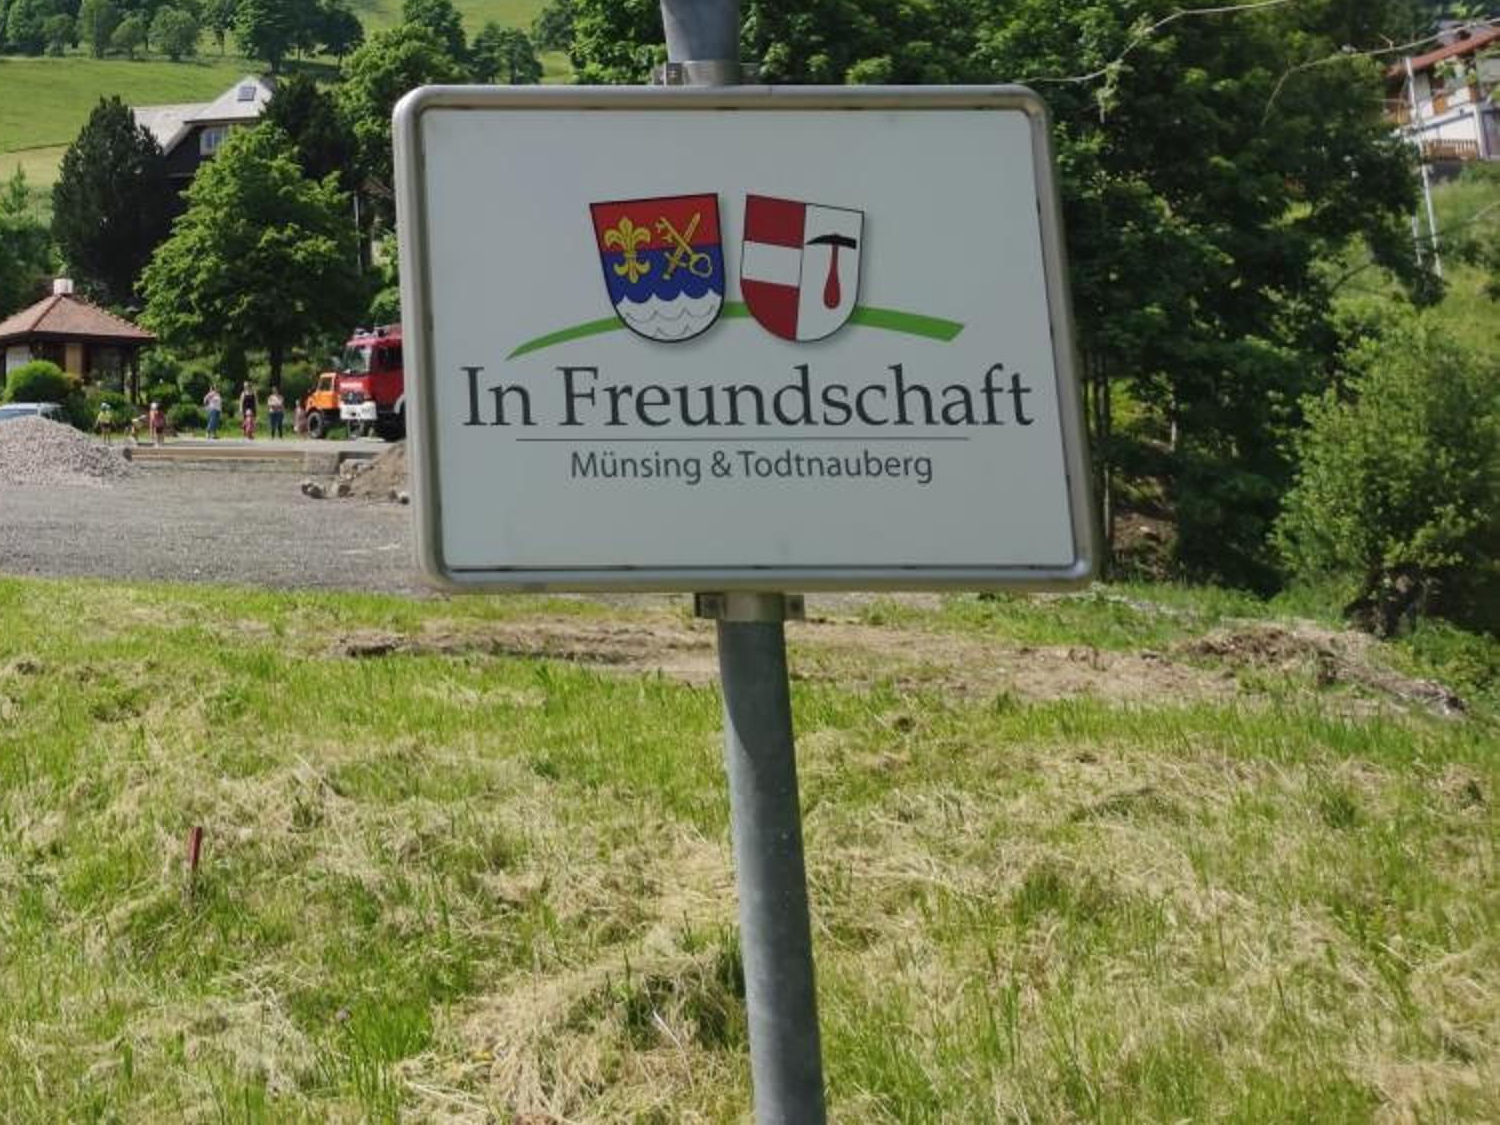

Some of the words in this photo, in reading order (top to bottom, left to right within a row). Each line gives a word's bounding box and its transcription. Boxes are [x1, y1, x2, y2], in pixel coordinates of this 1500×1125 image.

[461, 366, 538, 426] In
[556, 362, 1035, 427] Freundschaft
[571, 450, 702, 486] Münsing
[710, 450, 733, 478] &
[736, 448, 933, 485] Todtnauberg
